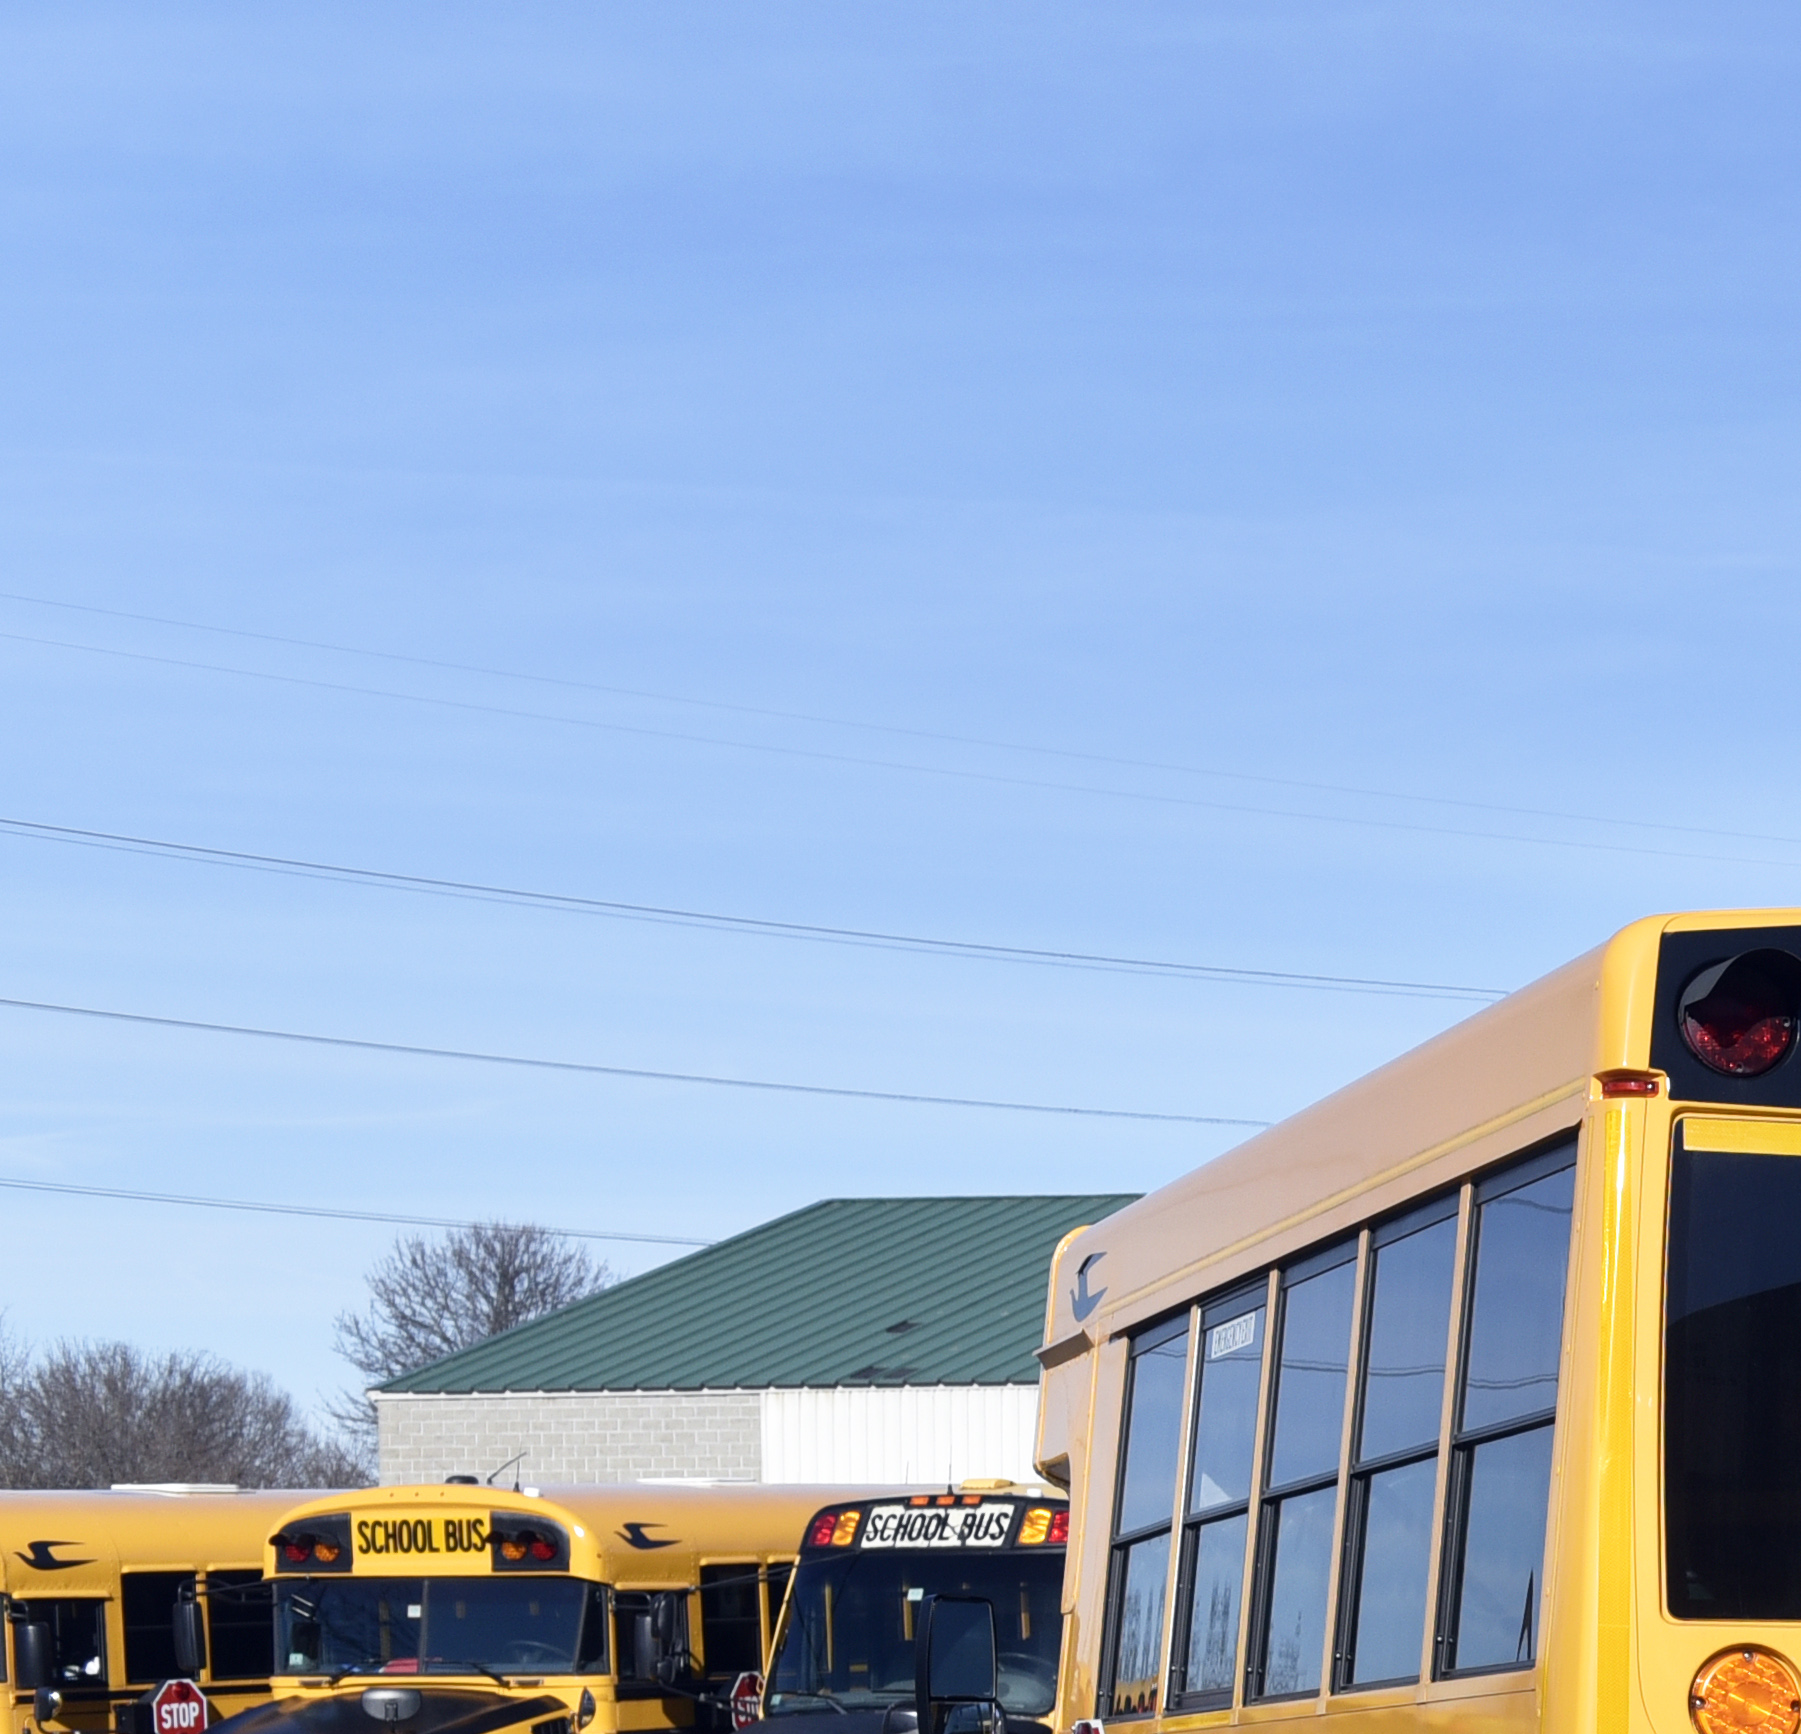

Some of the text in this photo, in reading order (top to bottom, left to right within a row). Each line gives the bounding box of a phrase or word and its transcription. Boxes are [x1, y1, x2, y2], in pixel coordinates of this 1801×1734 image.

[357, 1518, 486, 1554] SCHOOL BUS
[866, 1512, 1010, 1541] SCHOOL BUS
[161, 1702, 199, 1729] STOP
[737, 1696, 760, 1722] STO
